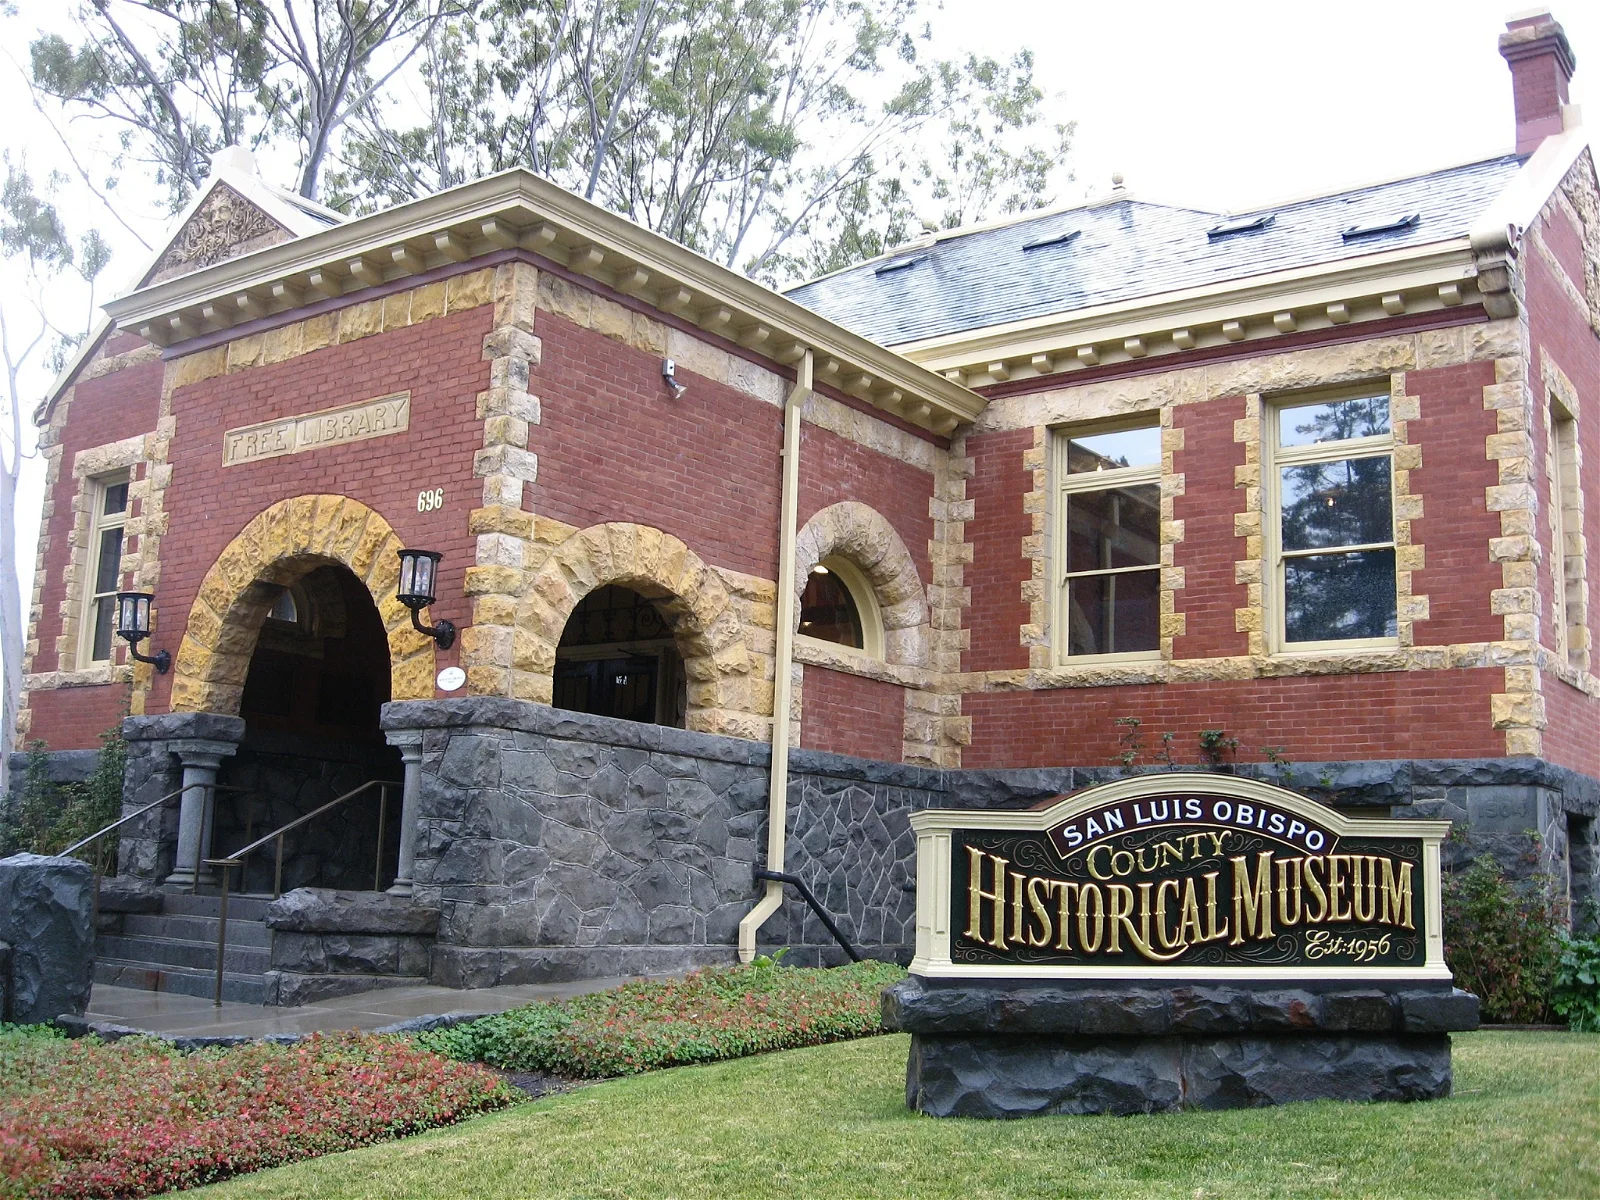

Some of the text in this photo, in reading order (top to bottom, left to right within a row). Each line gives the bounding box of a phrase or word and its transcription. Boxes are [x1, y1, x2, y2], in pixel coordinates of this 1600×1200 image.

[229, 399, 406, 461] FREE LIBRARY
[417, 487, 444, 512] 696
[1063, 799, 1325, 852] SAN LUIS OBISPO
[1086, 829, 1233, 881] COUNTY
[963, 845, 1416, 962] HISTORICAL MUSEUM
